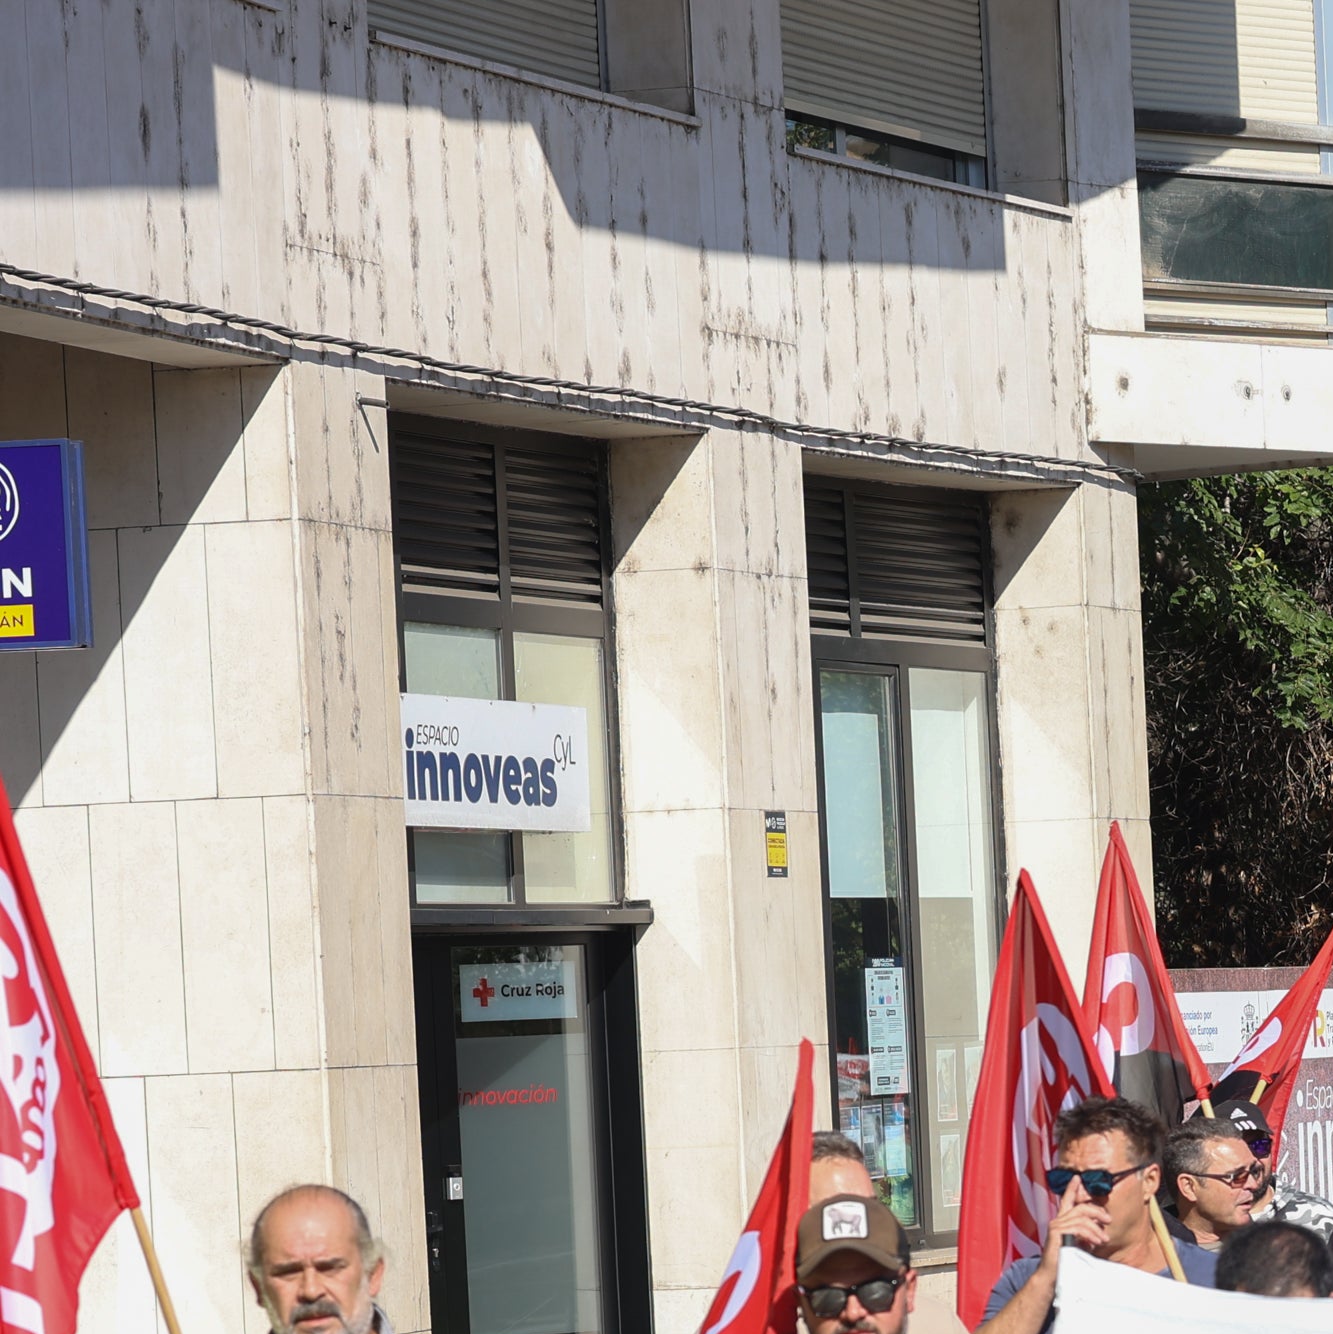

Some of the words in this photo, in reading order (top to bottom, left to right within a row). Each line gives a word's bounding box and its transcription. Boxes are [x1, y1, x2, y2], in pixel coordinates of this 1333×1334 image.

[416, 724, 460, 747] ESPACIO
[406, 728, 558, 807] innoveas
[553, 734, 576, 771] CyL
[501, 983, 532, 997] Cruz
[536, 981, 565, 998] Roja
[457, 1083, 558, 1107] innovación
